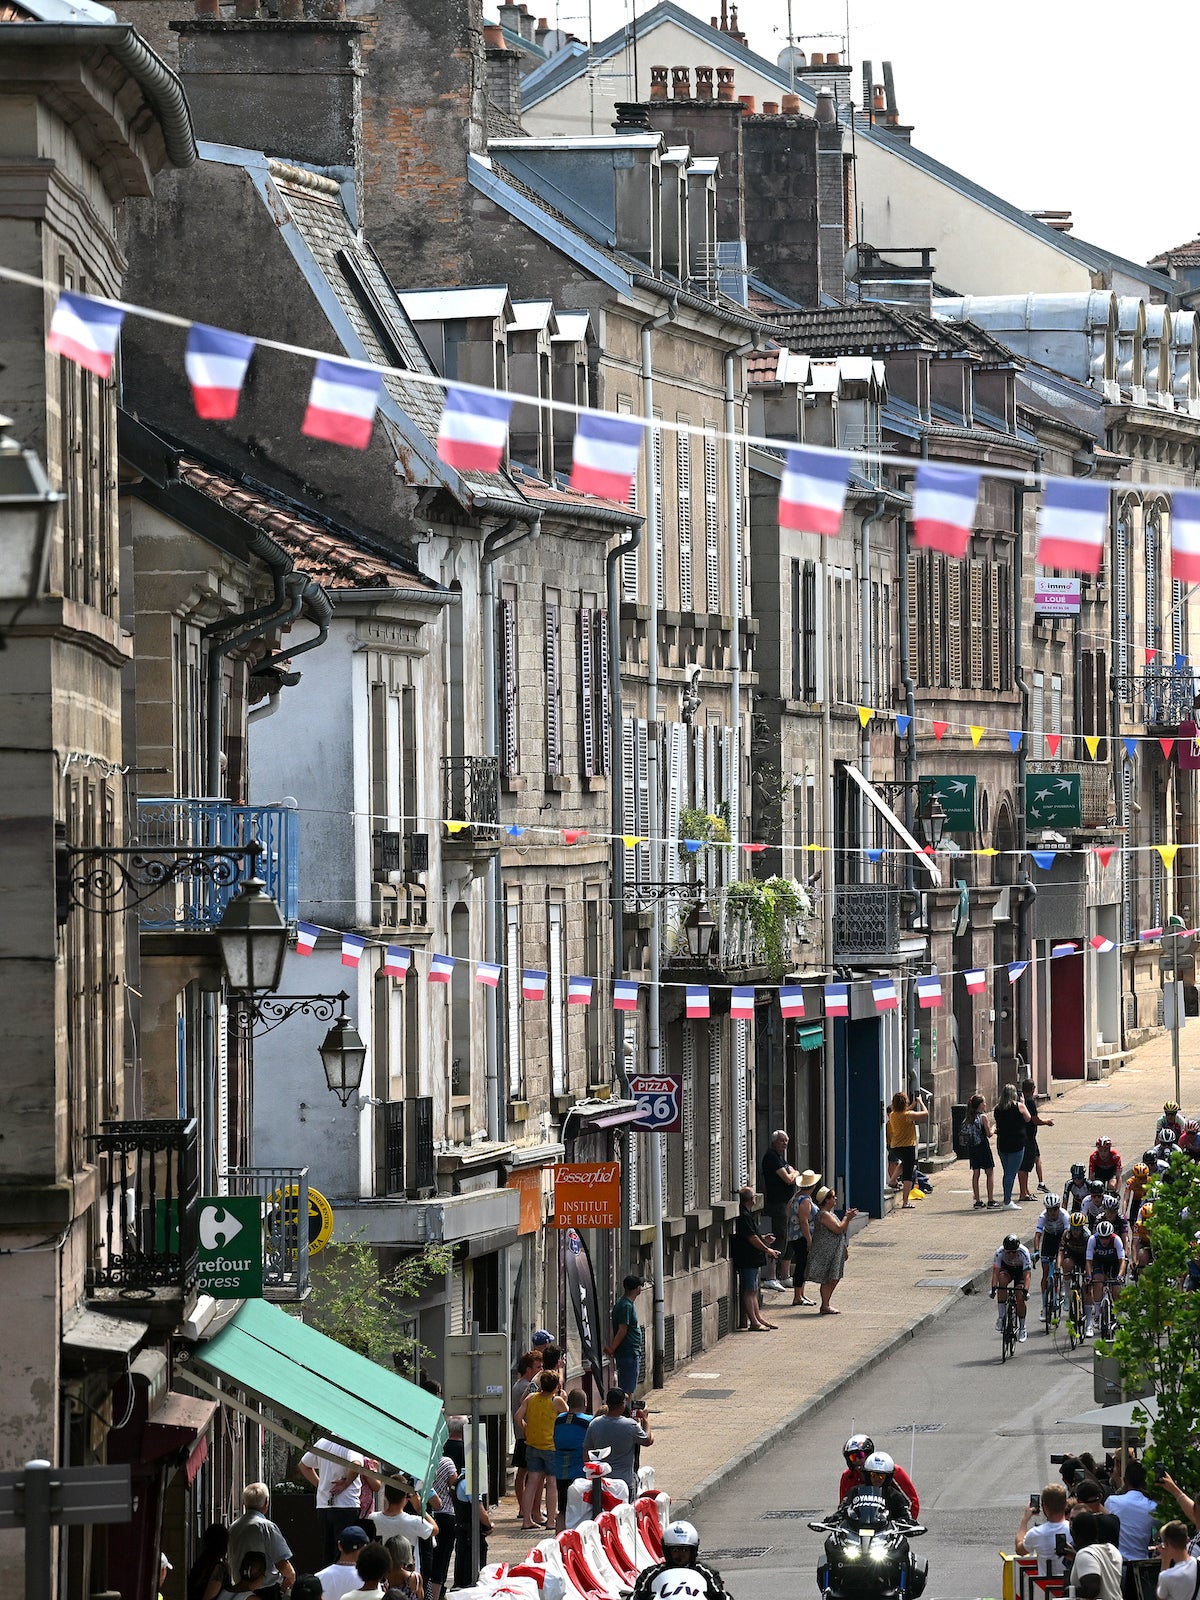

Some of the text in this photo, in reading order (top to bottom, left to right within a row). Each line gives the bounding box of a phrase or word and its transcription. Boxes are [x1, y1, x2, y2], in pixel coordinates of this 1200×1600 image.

[637, 1082, 669, 1091] PIZZA
[635, 1095, 670, 1119] 66
[555, 1166, 617, 1188] Essentiel
[563, 1201, 608, 1211] INSTITUT
[559, 1214, 614, 1225] DE BEAUTE
[198, 1256, 252, 1273] refour
[198, 1276, 241, 1289] press
[859, 1495, 886, 1506] YAMAHA
